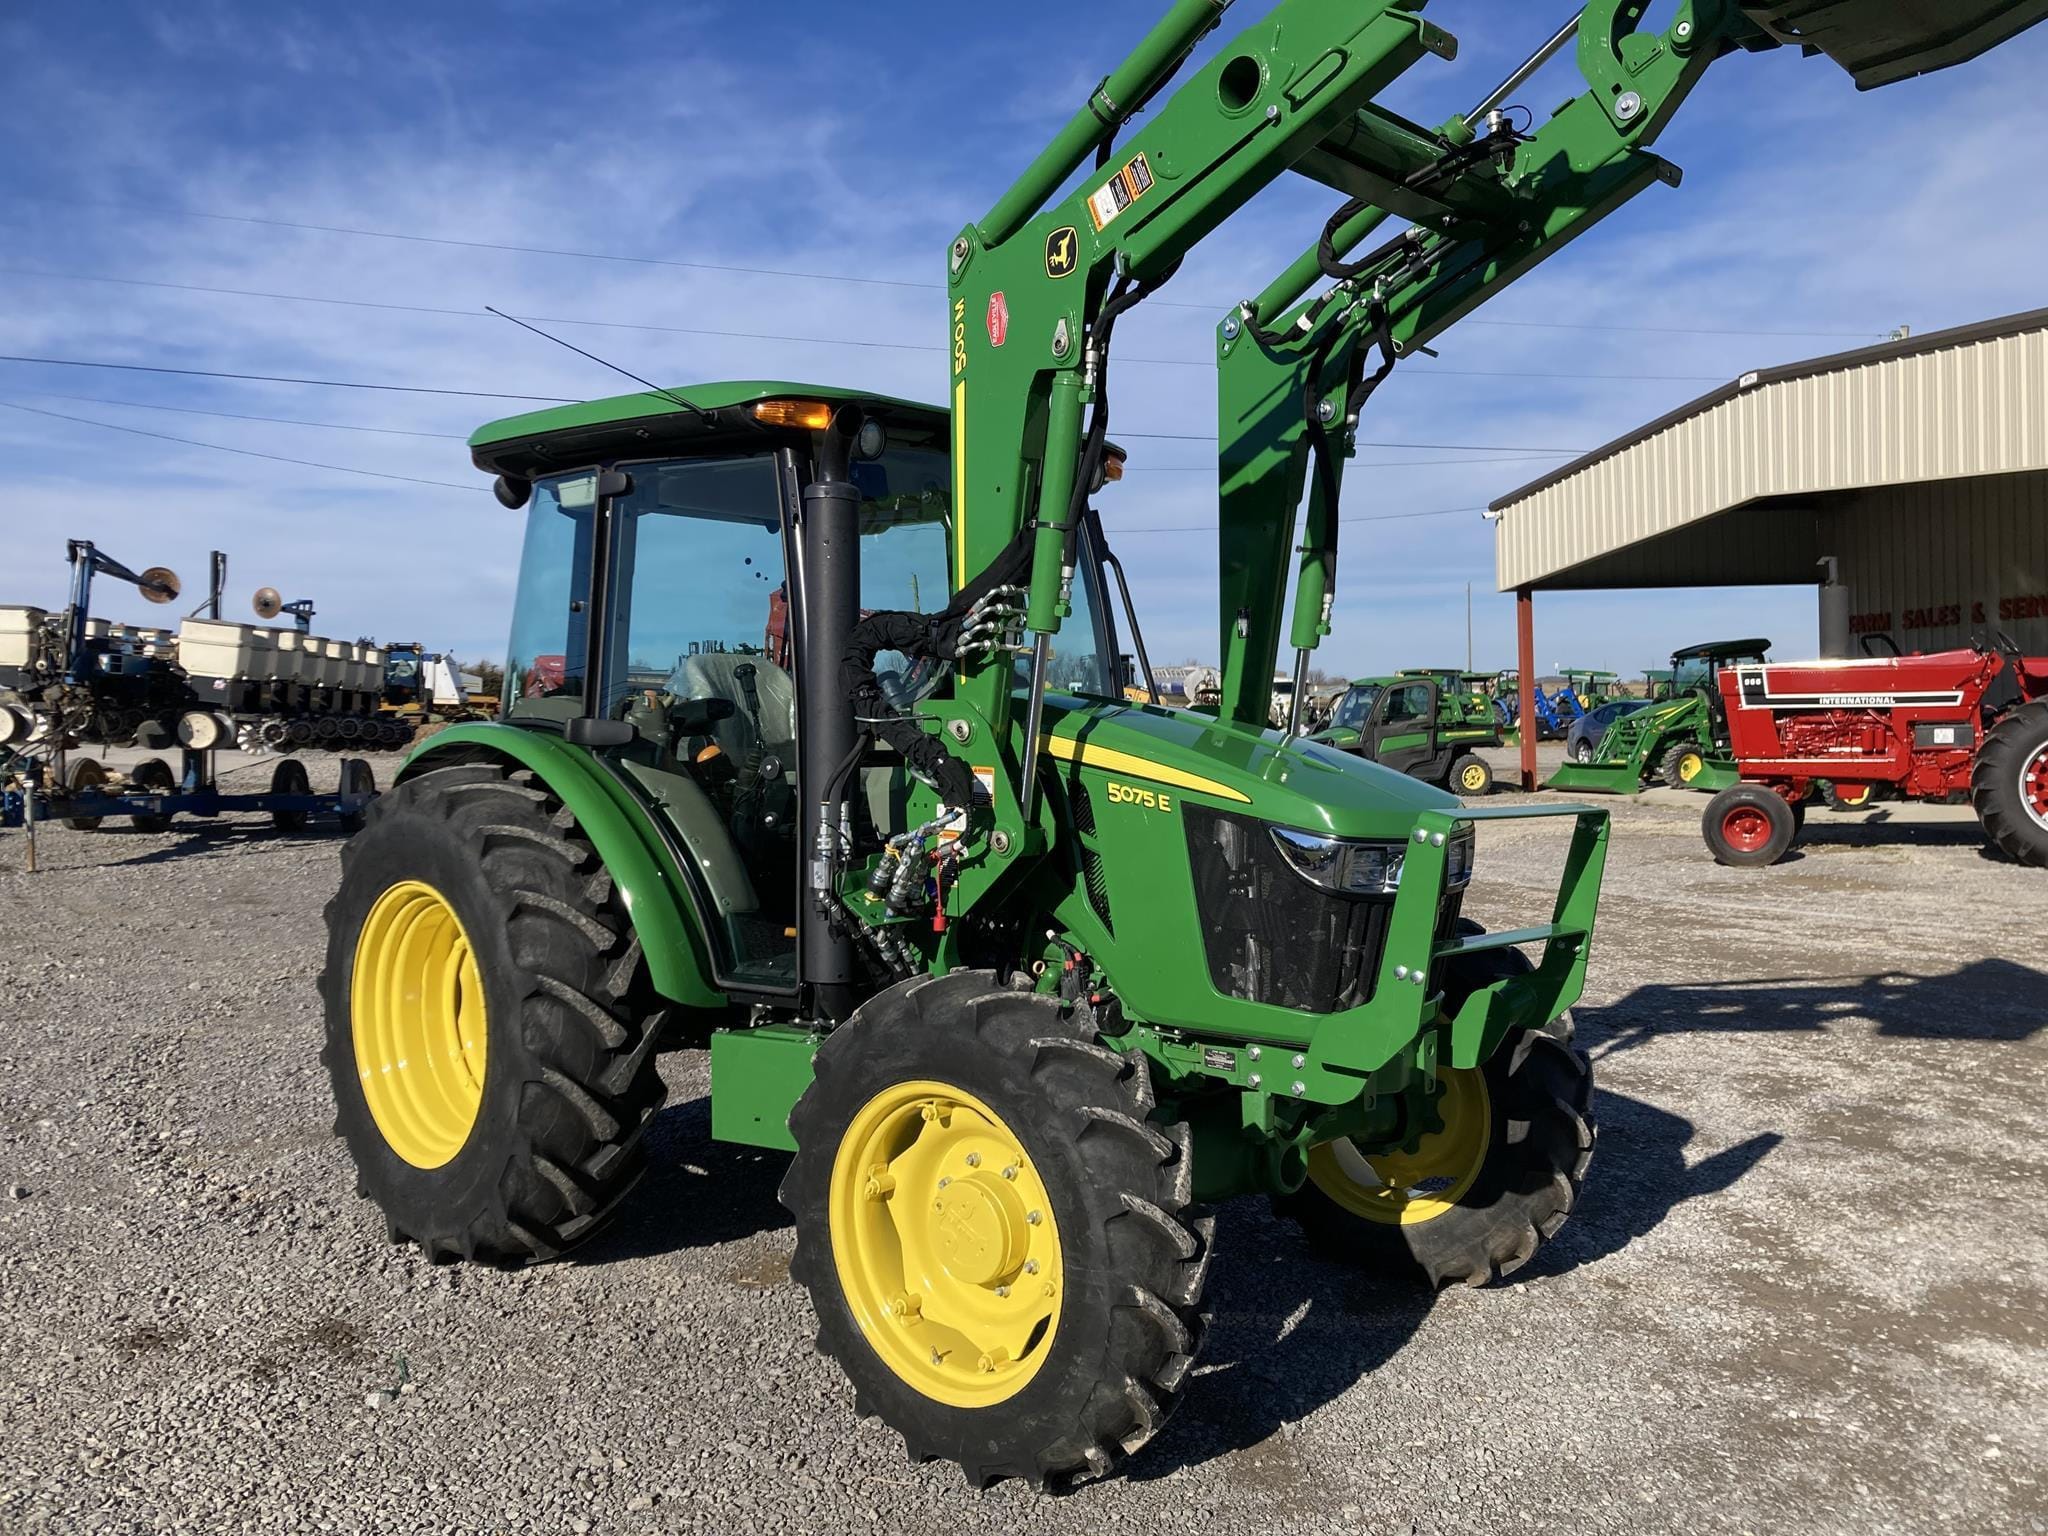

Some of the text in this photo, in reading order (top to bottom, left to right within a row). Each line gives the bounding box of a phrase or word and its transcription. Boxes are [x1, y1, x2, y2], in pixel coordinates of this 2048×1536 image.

[954, 297, 967, 376] 500M
[1849, 613, 1891, 634] FARM
[1902, 605, 1961, 630] SALES
[1971, 602, 1986, 623] &
[1819, 696, 1896, 704] INTERNATIONAL
